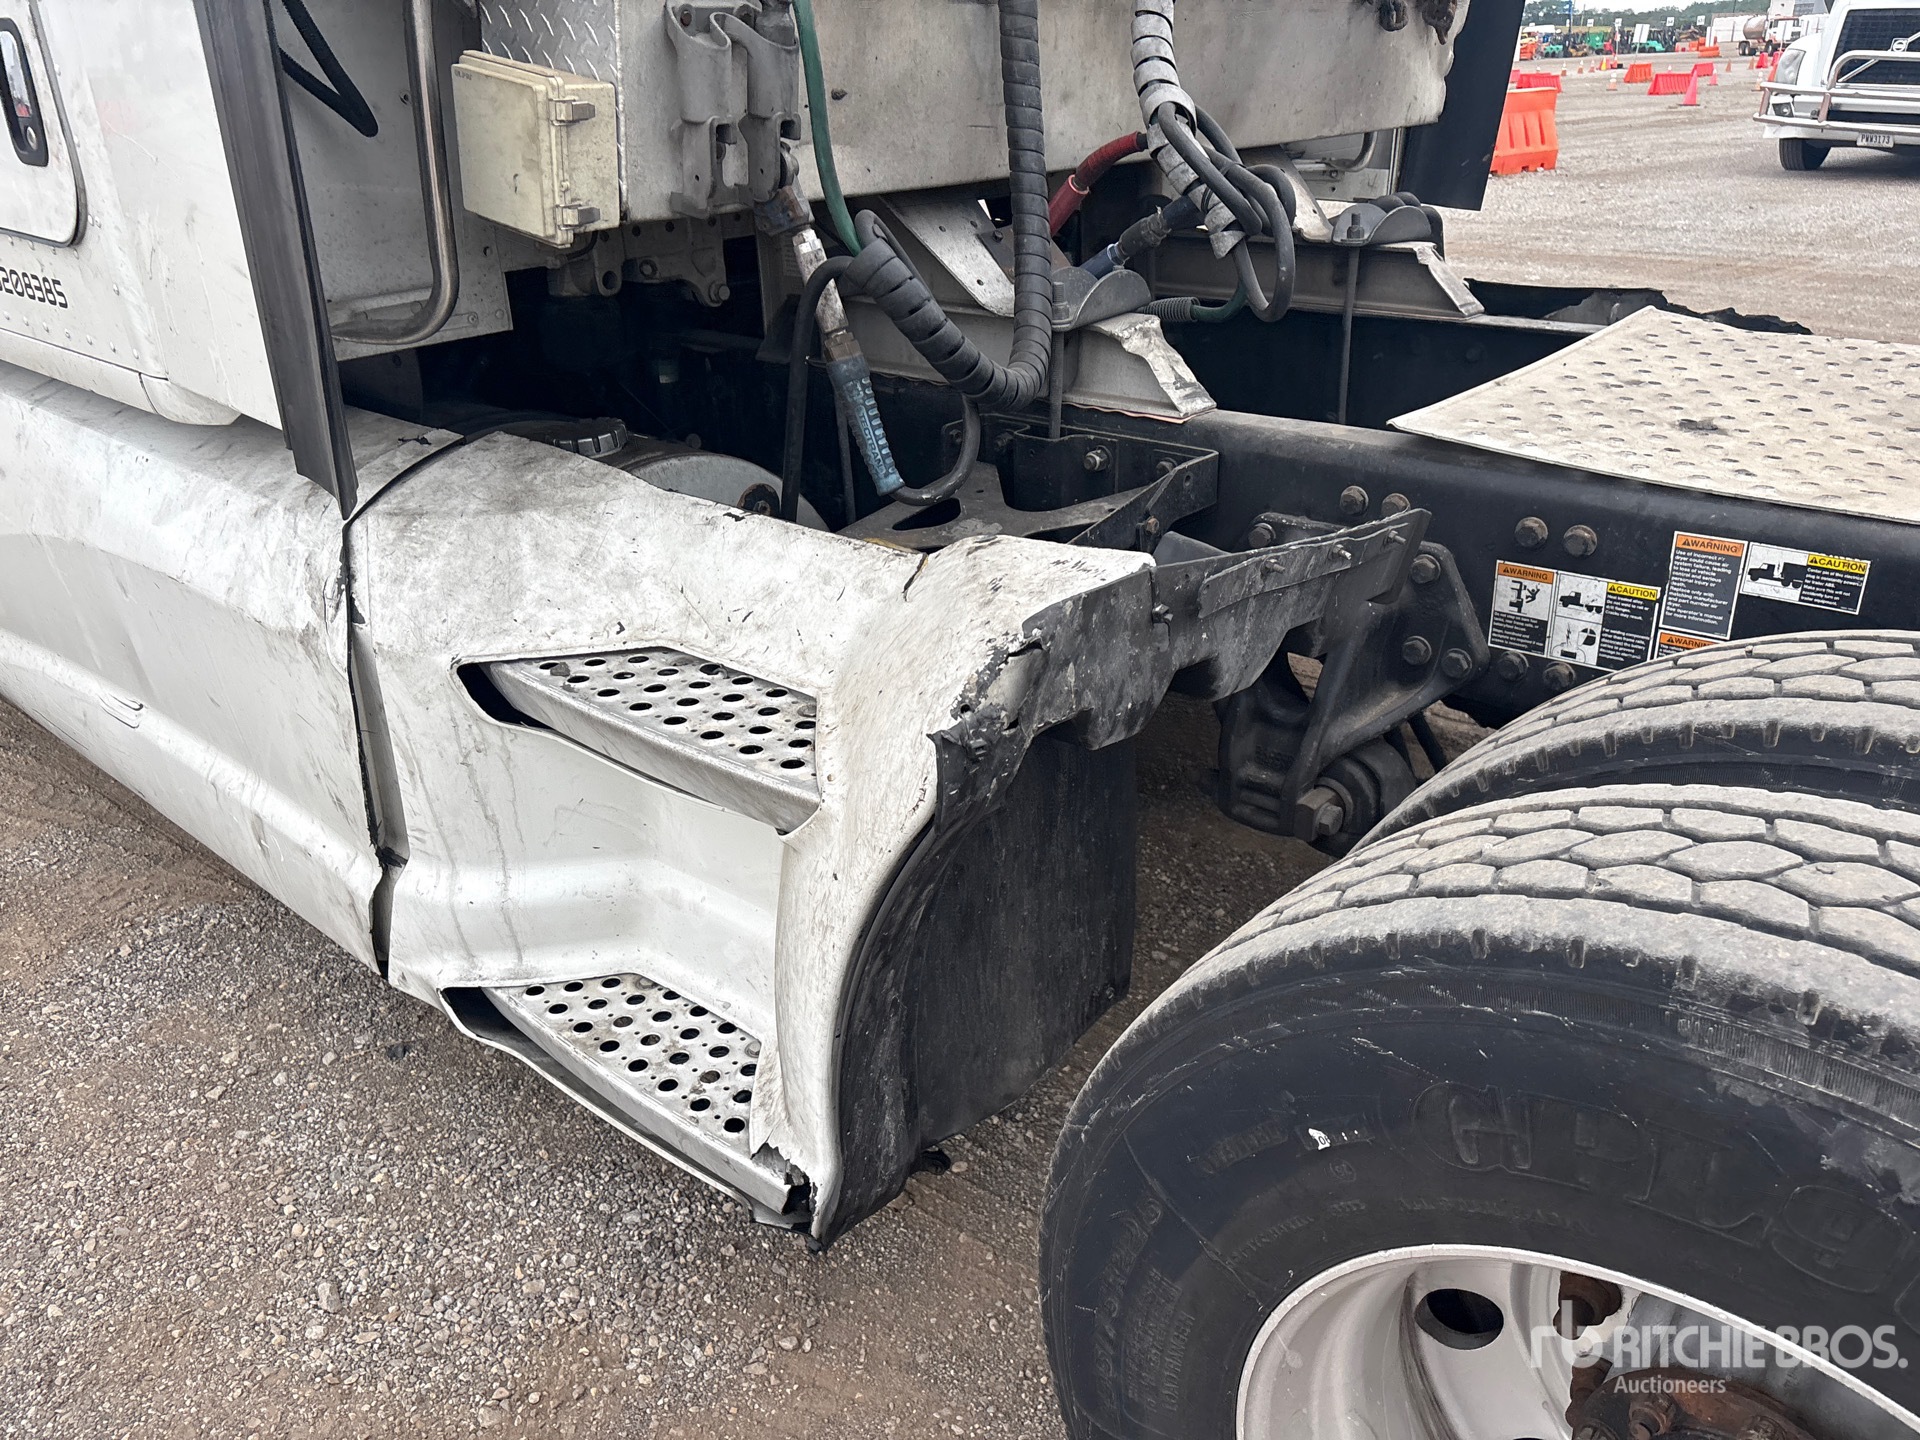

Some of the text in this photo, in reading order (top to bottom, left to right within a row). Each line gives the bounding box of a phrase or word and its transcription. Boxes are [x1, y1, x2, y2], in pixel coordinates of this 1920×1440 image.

[1691, 540, 1738, 552] WARNING
[1819, 558, 1865, 572] CAUTION
[1510, 569, 1547, 580] WARNING
[1617, 586, 1655, 598] CAUTION
[1693, 596, 1728, 605] manufacturer
[1675, 637, 1710, 647] WARNIN
